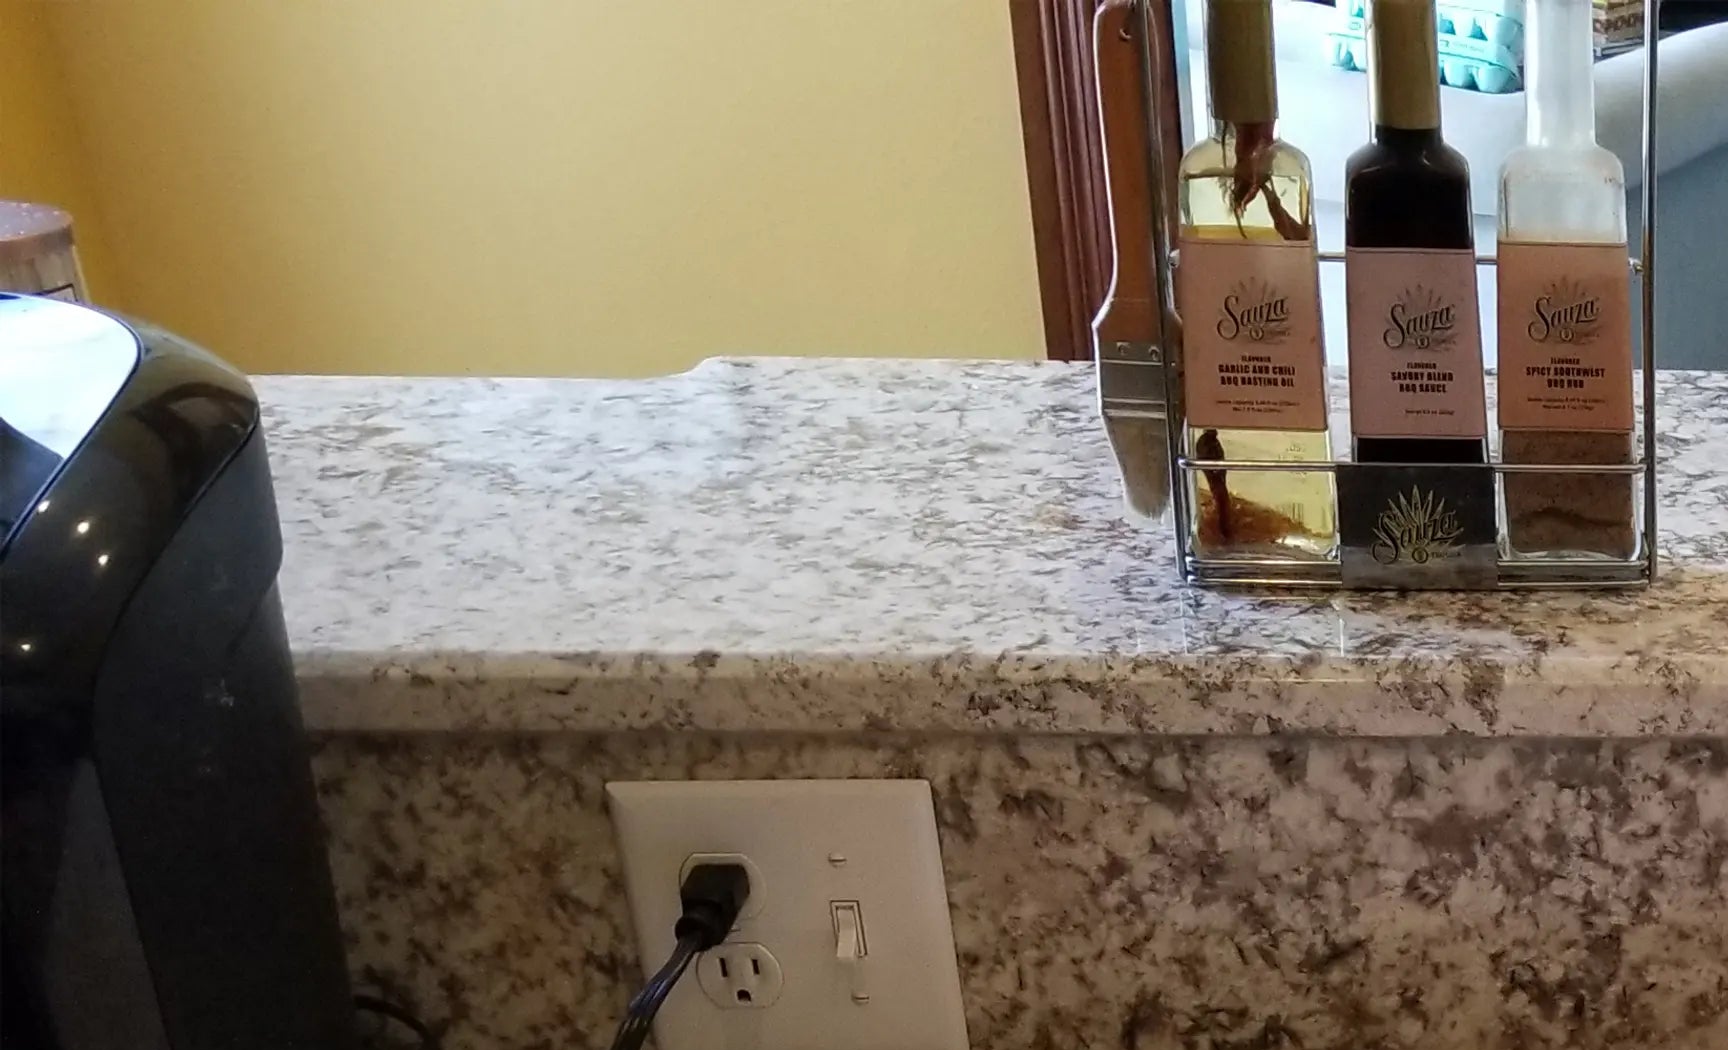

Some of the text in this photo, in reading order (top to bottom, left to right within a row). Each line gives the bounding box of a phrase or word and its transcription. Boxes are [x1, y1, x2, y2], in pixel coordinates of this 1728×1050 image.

[1216, 294, 1290, 341] Sauza
[1526, 296, 1599, 342] Sauza
[1383, 302, 1455, 349] Sauza
[1218, 364, 1296, 376] GARLIC AND CHILI
[1526, 366, 1606, 378] SPICY SOUTHWEST
[1220, 375, 1295, 388] BBQ BASTING OIL
[1391, 371, 1454, 382] SAVORY BLEND
[1399, 383, 1448, 394] BBQ SAUCE
[1547, 378, 1565, 389] BBQ
[1371, 510, 1459, 565] Sauza
